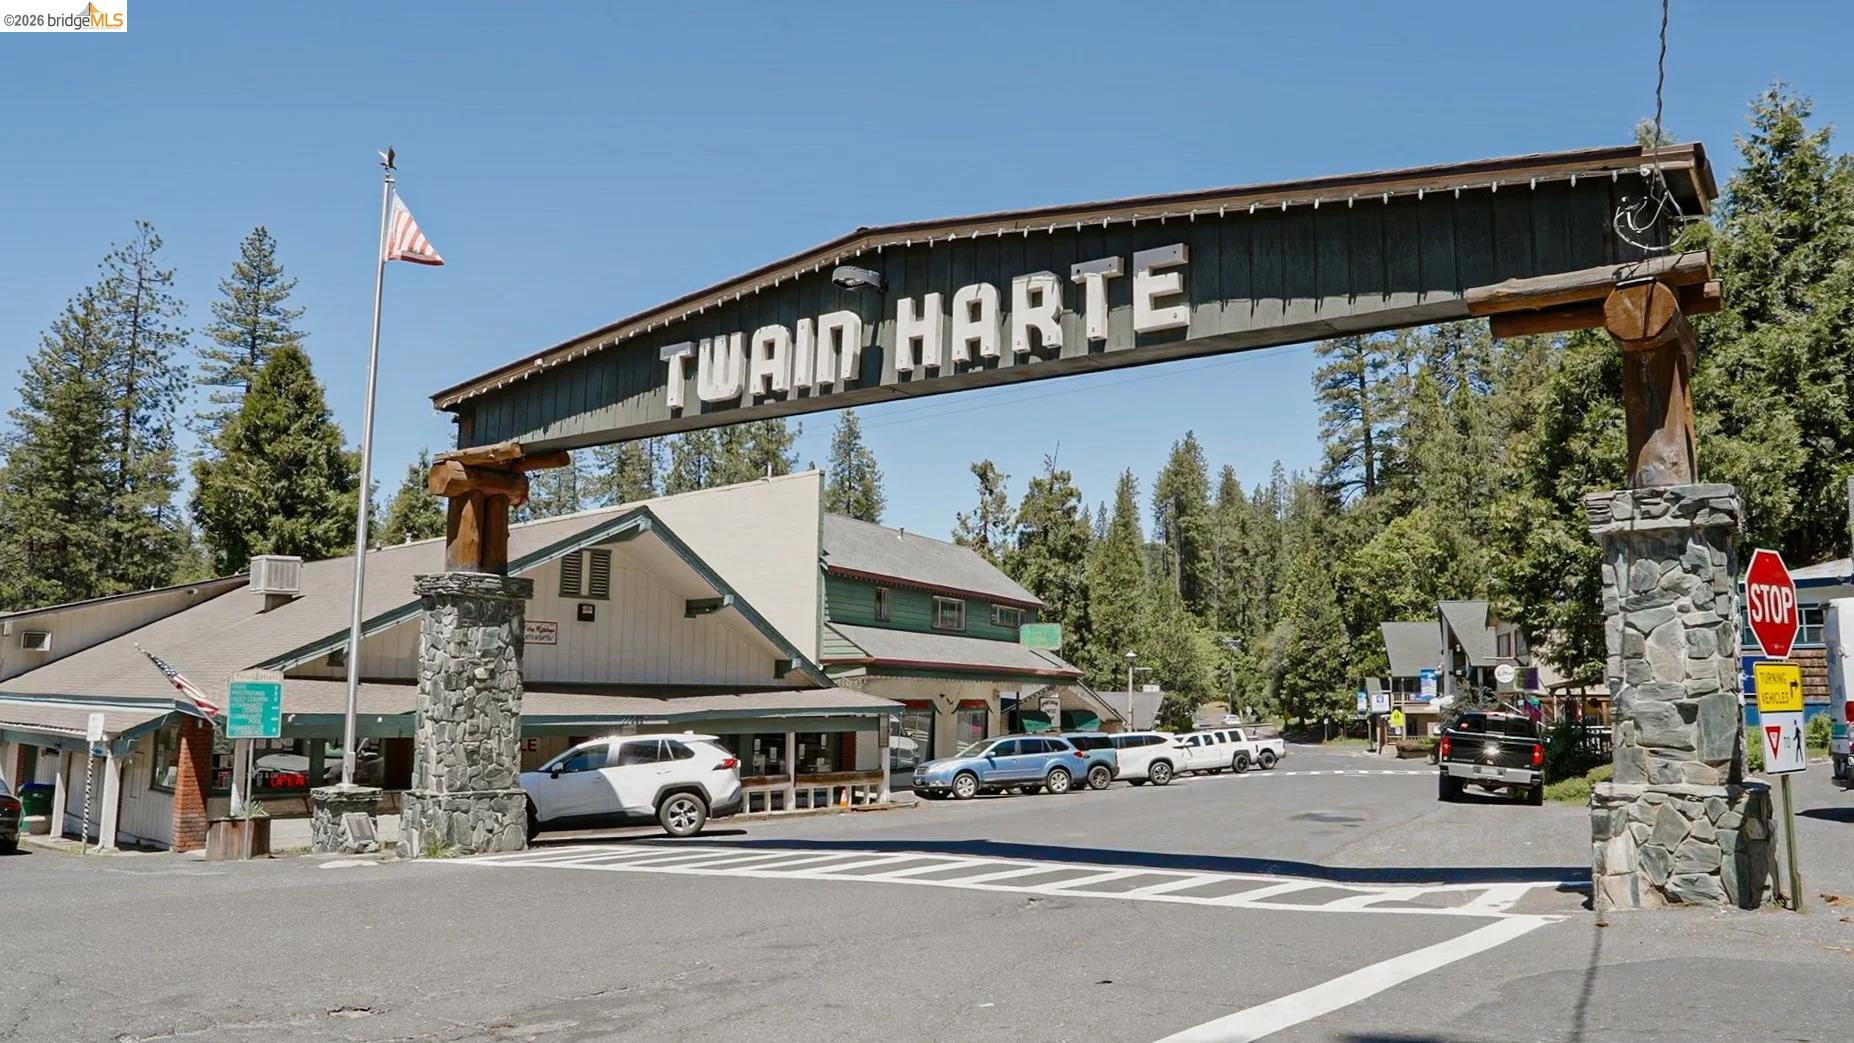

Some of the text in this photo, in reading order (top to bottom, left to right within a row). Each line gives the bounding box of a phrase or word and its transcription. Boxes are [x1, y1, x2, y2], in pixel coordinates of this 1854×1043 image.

[660, 243, 1190, 408] TWAIN HARTE
[1750, 583, 1794, 625] STOP
[1759, 671, 1787, 685] TURNING
[1761, 691, 1790, 704] VEHICLES
[271, 773, 305, 788] OPEN
